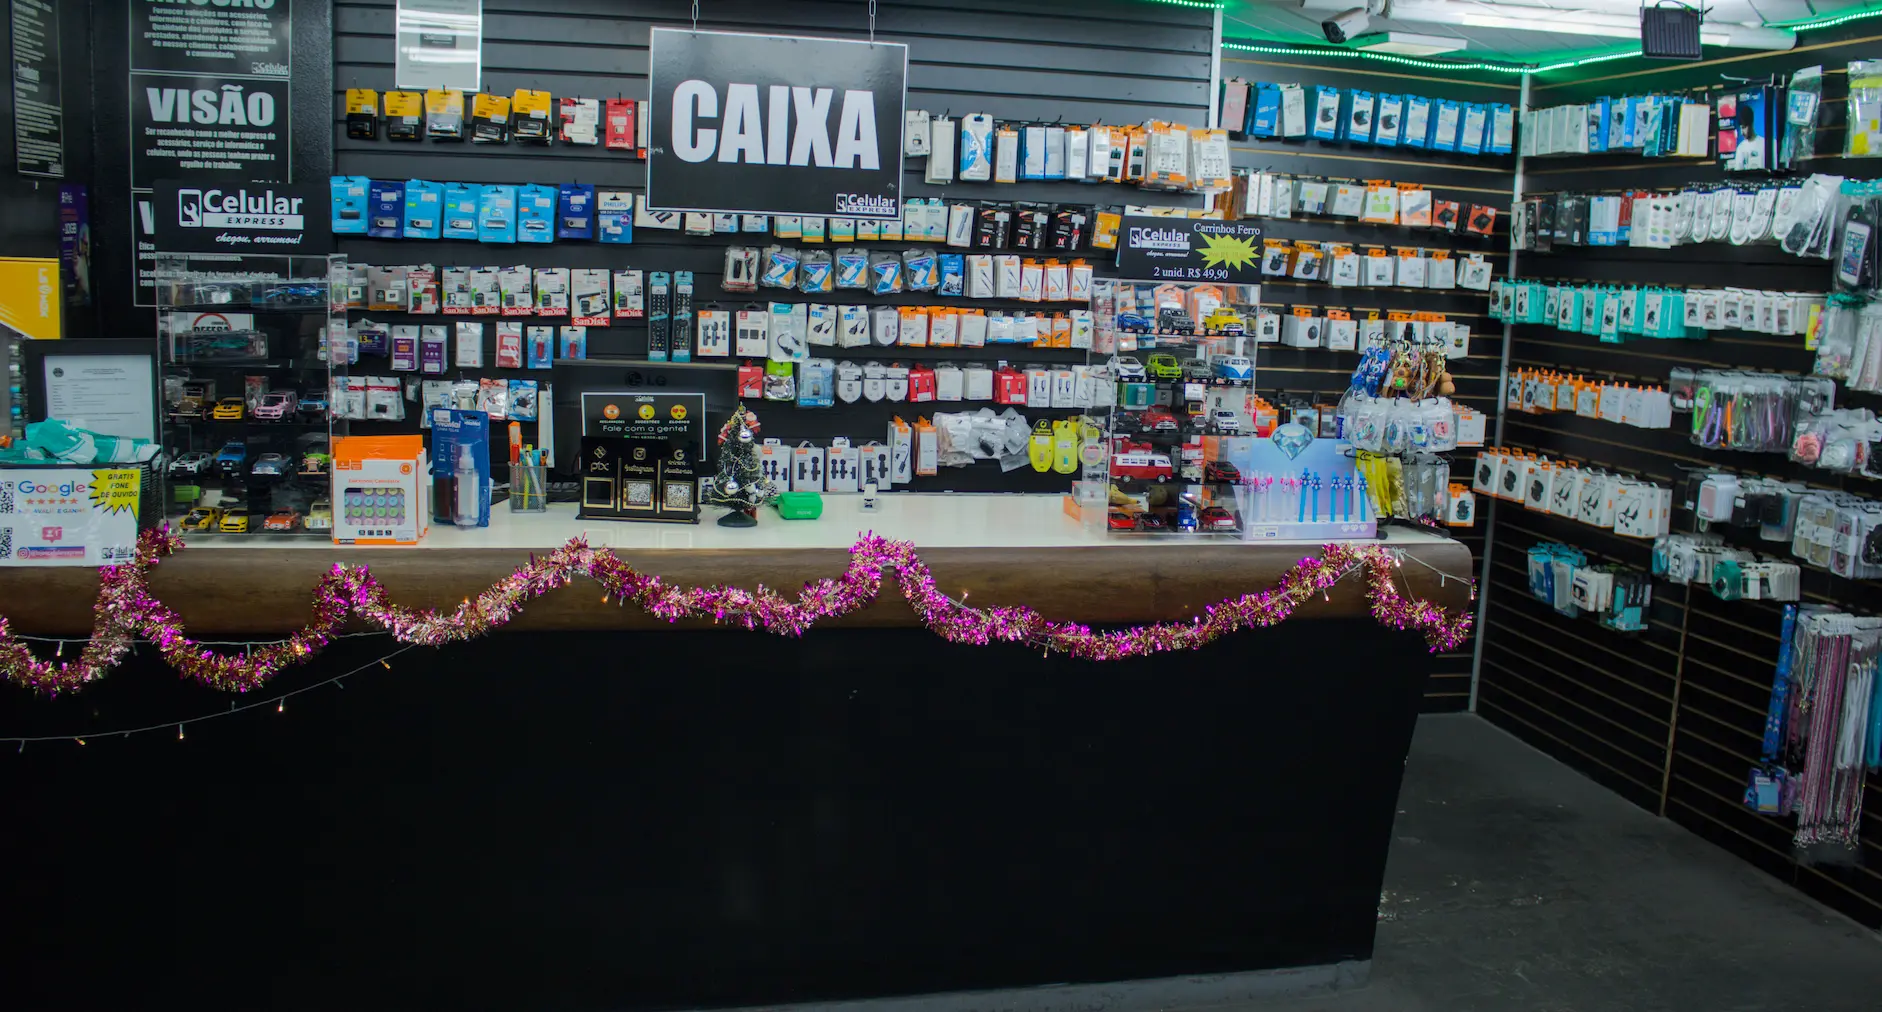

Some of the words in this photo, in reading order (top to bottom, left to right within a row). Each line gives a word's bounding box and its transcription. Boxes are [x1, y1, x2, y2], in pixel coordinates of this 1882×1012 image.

[146, 84, 274, 126] VISÃO
[672, 79, 880, 170] CAIXA
[203, 189, 303, 215] Celular
[847, 194, 896, 207] Celular
[227, 217, 285, 226] EXPRESS
[1142, 228, 1190, 242] Celular
[1194, 222, 1235, 234] Carrinhos
[1238, 225, 1260, 235] Ferro
[254, 234, 303, 244] arrumou!
[1154, 267, 1160, 276] 2
[1162, 268, 1184, 277] unid.
[1188, 268, 1200, 278] R$
[1202, 269, 1228, 279] 49,90
[18, 481, 86, 496] Google
